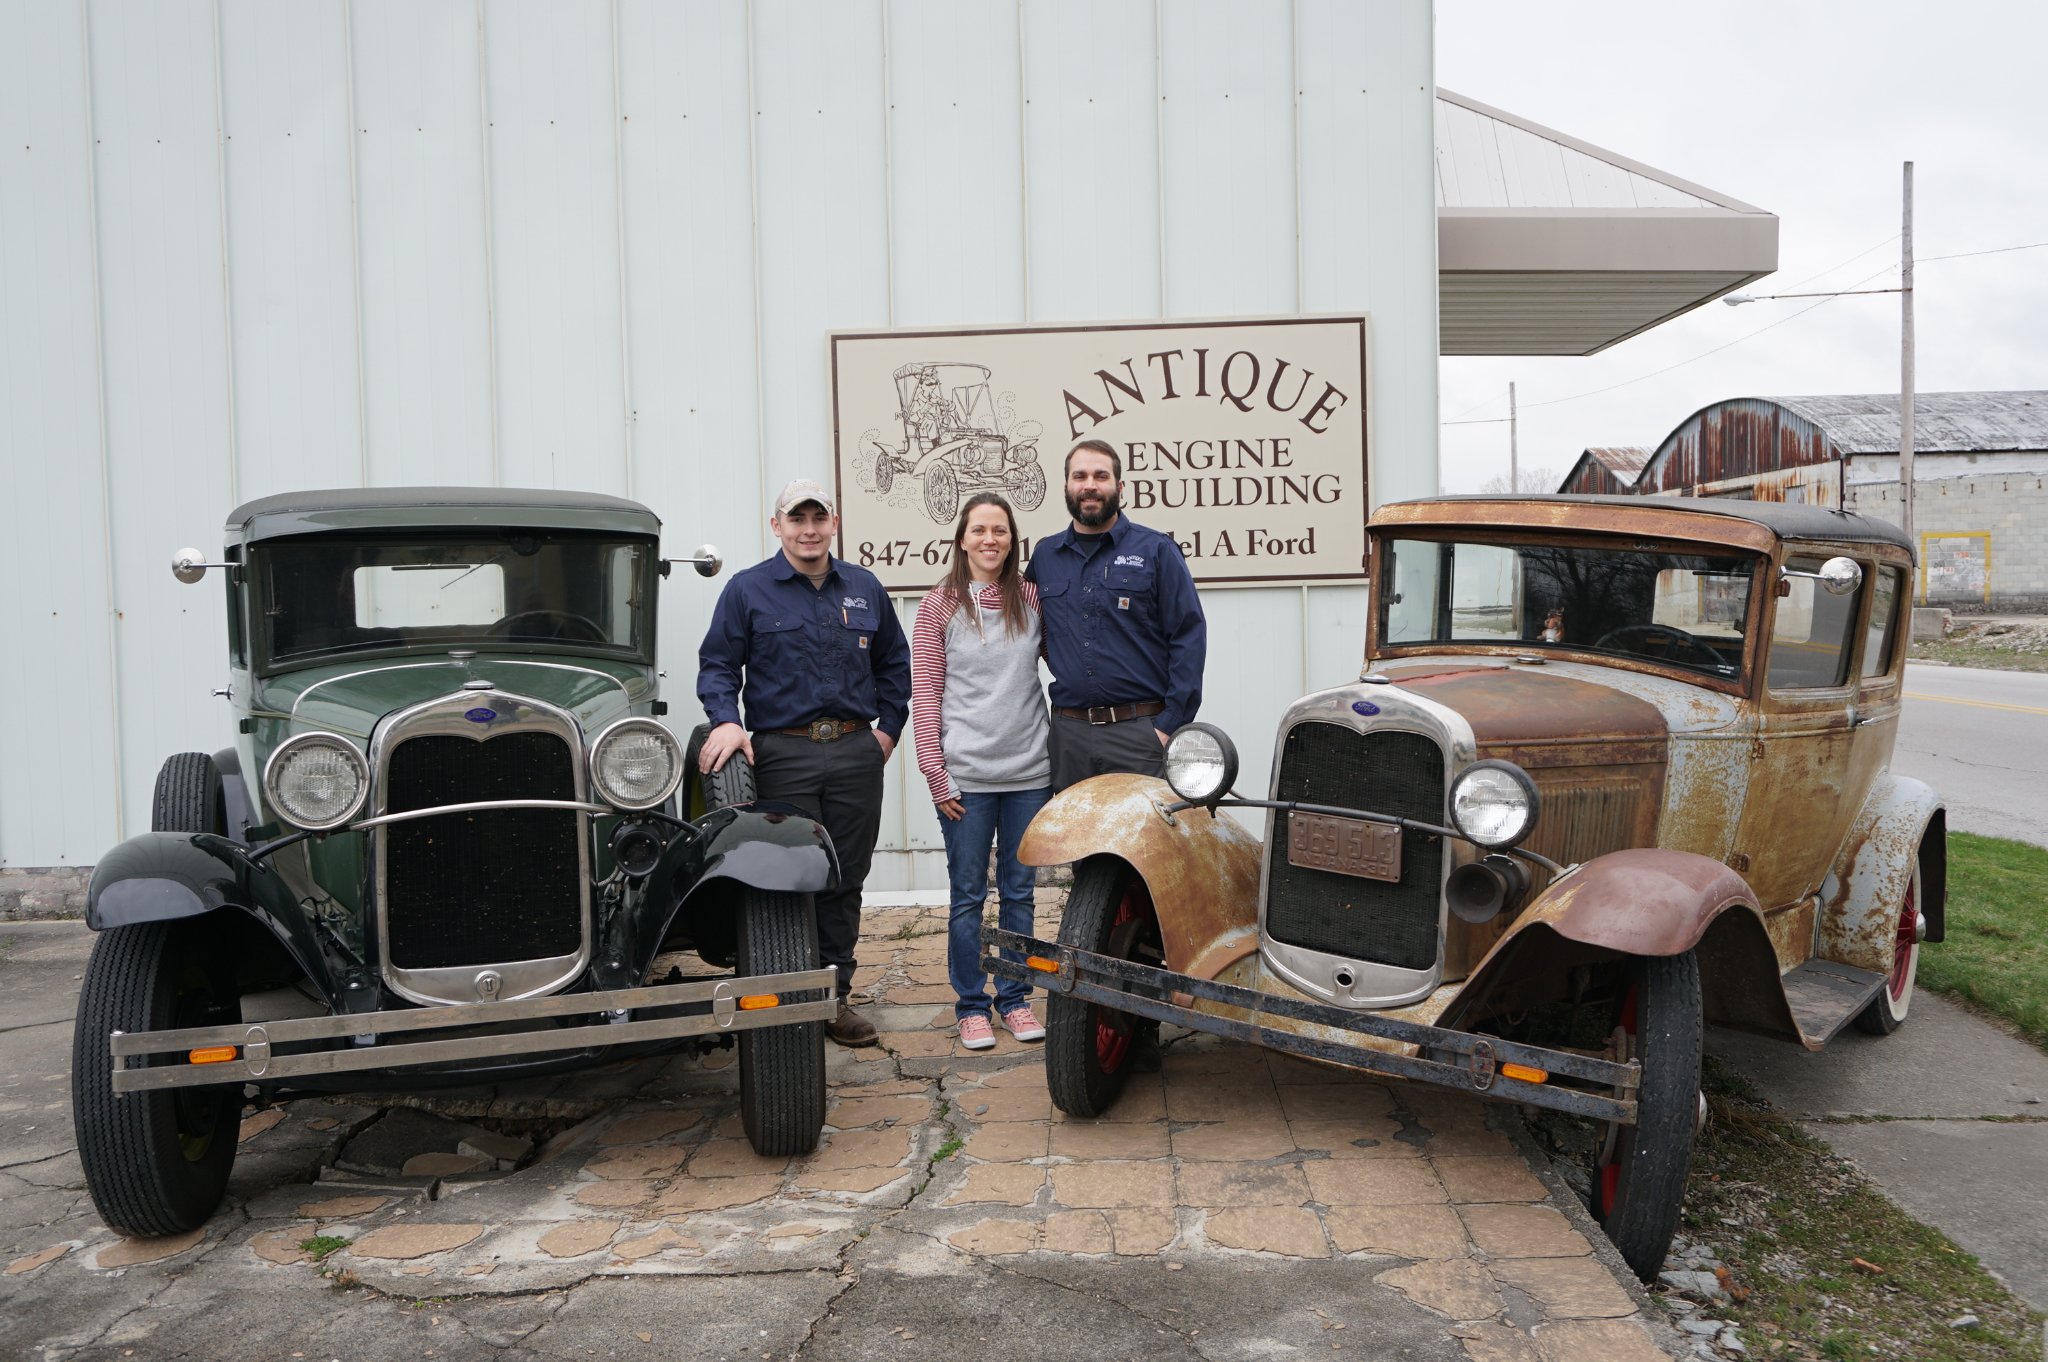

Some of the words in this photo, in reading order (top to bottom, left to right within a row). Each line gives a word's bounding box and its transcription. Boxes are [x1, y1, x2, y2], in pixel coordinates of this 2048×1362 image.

[1062, 348, 1348, 441] ANTIQUE
[1124, 437, 1294, 472] ENGINE
[1119, 474, 1343, 509] BUILDING
[1210, 529, 1239, 557] A
[1245, 527, 1318, 556] Ford
[1294, 816, 1339, 856] 369
[1347, 824, 1396, 865] 513
